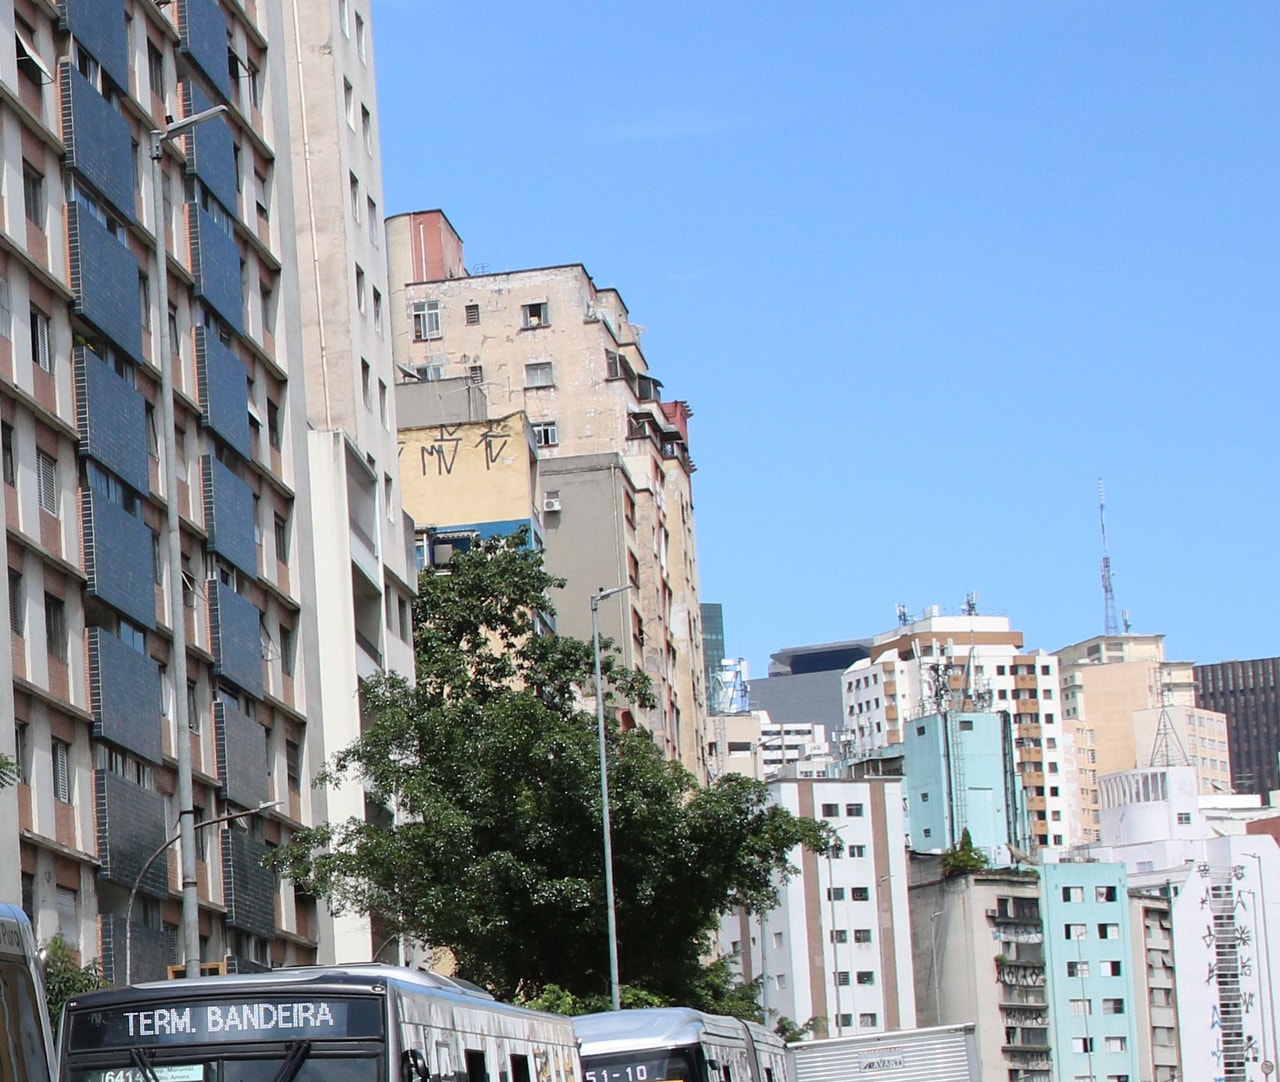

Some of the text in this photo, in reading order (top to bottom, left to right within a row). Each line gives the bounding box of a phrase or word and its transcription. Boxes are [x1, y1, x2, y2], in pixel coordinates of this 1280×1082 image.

[2, 923, 20, 947] Puro
[123, 1002, 334, 1037] TERM. BANDEIRA
